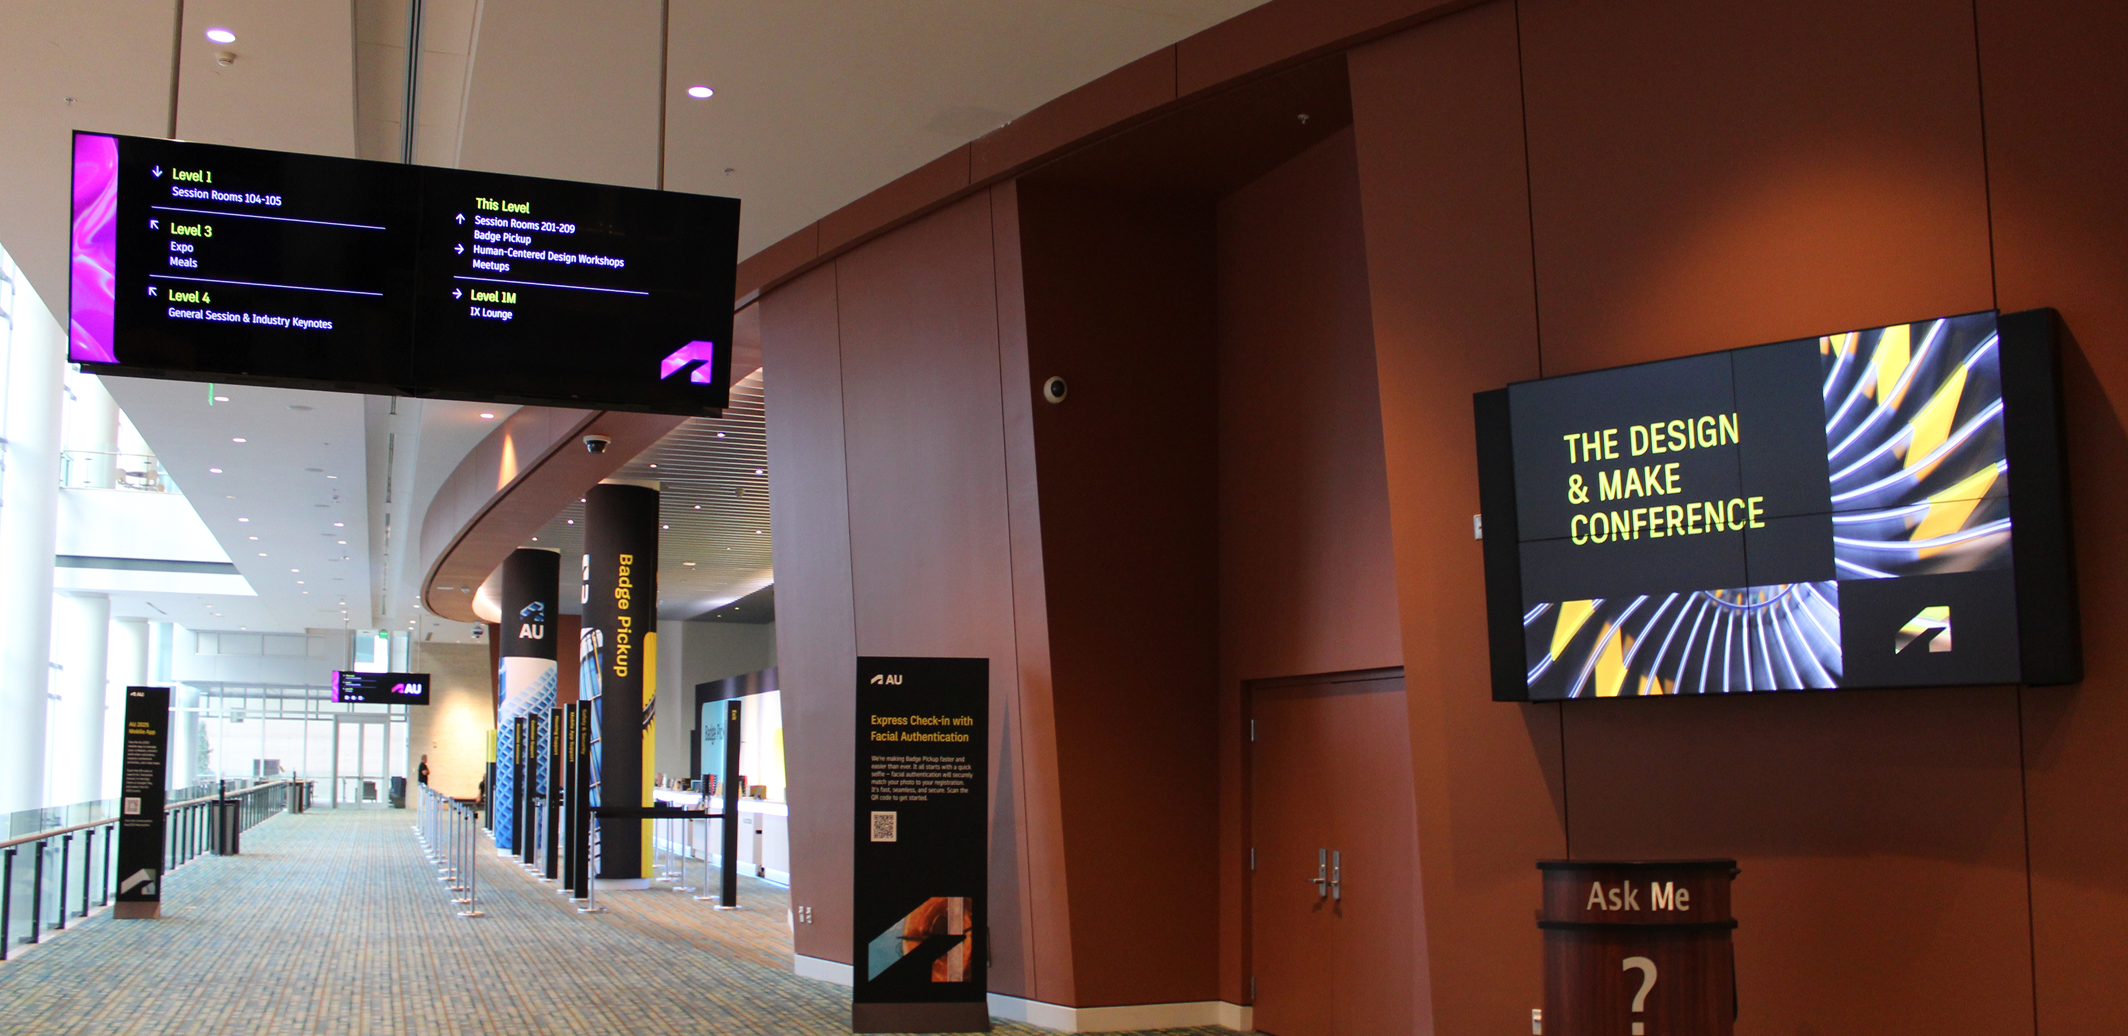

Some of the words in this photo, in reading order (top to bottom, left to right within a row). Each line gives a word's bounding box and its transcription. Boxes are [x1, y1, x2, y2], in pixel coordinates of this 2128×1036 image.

[172, 168, 203, 182] Level
[205, 171, 212, 183] 1
[172, 186, 208, 200] Session
[211, 190, 243, 202] Rooms
[244, 193, 282, 206] 104-105
[476, 197, 499, 211] This
[502, 200, 530, 214] Level
[171, 222, 202, 237] Level
[204, 226, 212, 238] 3
[475, 215, 508, 228] Session
[510, 219, 539, 231] Rooms
[541, 222, 575, 233] 201-209
[474, 230, 501, 244] Badge
[503, 233, 531, 245] Pickup
[171, 241, 194, 253] Expo
[170, 256, 198, 268] Meals
[473, 245, 546, 260] Human-Centered
[548, 251, 576, 264] Design
[578, 253, 624, 267] Workshops
[473, 259, 510, 272] Meetups
[169, 289, 200, 303] Level
[202, 292, 210, 304] 4
[471, 289, 499, 302] Level
[501, 292, 516, 304] 1M
[169, 307, 203, 320] General
[205, 310, 241, 322] Session
[242, 312, 250, 323] &
[252, 313, 290, 328] Industry
[292, 317, 332, 330] Keynotes
[471, 307, 480, 316] IX
[482, 308, 513, 320] Lounge
[1563, 428, 1620, 464] THE
[1630, 412, 1740, 457] DESIGN
[1567, 474, 1590, 504] &
[1598, 462, 1681, 501] MAKE
[1571, 496, 1766, 545] CONFERENCE
[614, 553, 633, 610] Badge
[519, 623, 544, 640] AU
[613, 615, 631, 678] Pickup
[885, 675, 902, 685] AU
[404, 683, 422, 694] AU
[871, 715, 908, 727] Express
[910, 715, 950, 725] Check-in
[953, 716, 973, 726] with
[871, 731, 898, 741] Facial
[900, 732, 969, 742] Authentication
[1586, 880, 1640, 911] Ask
[1651, 881, 1689, 911] Me
[1622, 956, 1657, 1036] ?
